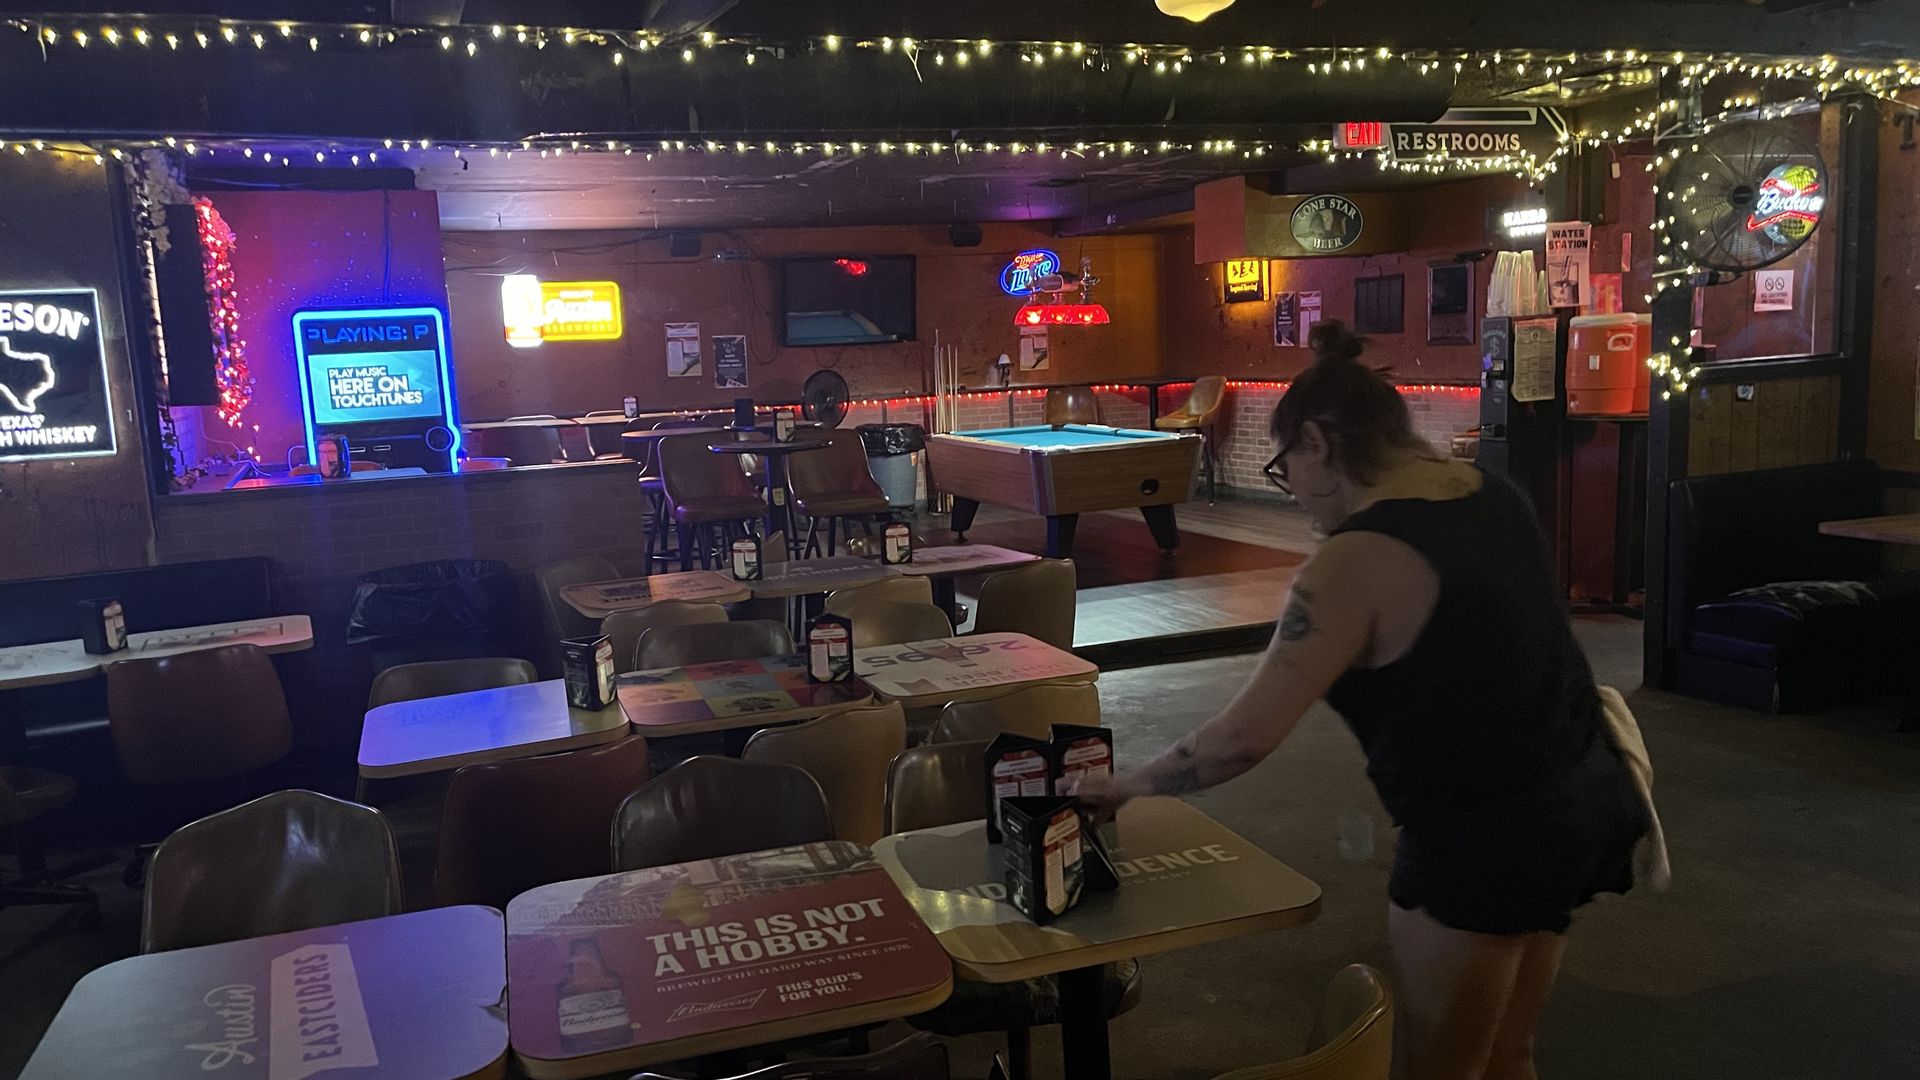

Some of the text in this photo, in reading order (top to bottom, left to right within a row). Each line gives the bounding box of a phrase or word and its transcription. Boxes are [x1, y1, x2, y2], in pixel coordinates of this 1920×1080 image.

[1396, 132, 1521, 151] RESTROOMS
[1330, 198, 1357, 220] STAR
[1313, 237, 1343, 249] BEER
[1551, 229, 1585, 239] WATER
[1549, 239, 1588, 250] STATION
[329, 366, 387, 379] PLAY MUSIC
[330, 375, 409, 395] HERE ON
[331, 391, 424, 409] TOUCHTUNES
[14, 425, 97, 446] WHISKEY
[645, 898, 885, 955] THIS IS NOT
[654, 924, 867, 977] A HOBBY.
[656, 975, 722, 993] BREWED
[725, 970, 755, 982] THE
[759, 961, 801, 977] HARD
[804, 957, 834, 967] WAY
[837, 948, 881, 961] SINCE
[776, 970, 864, 994] THIS BUD'S
[779, 984, 853, 1003] FOR YOU.
[292, 953, 343, 1063] EASTCIDERS
[186, 984, 259, 1071] Austin
